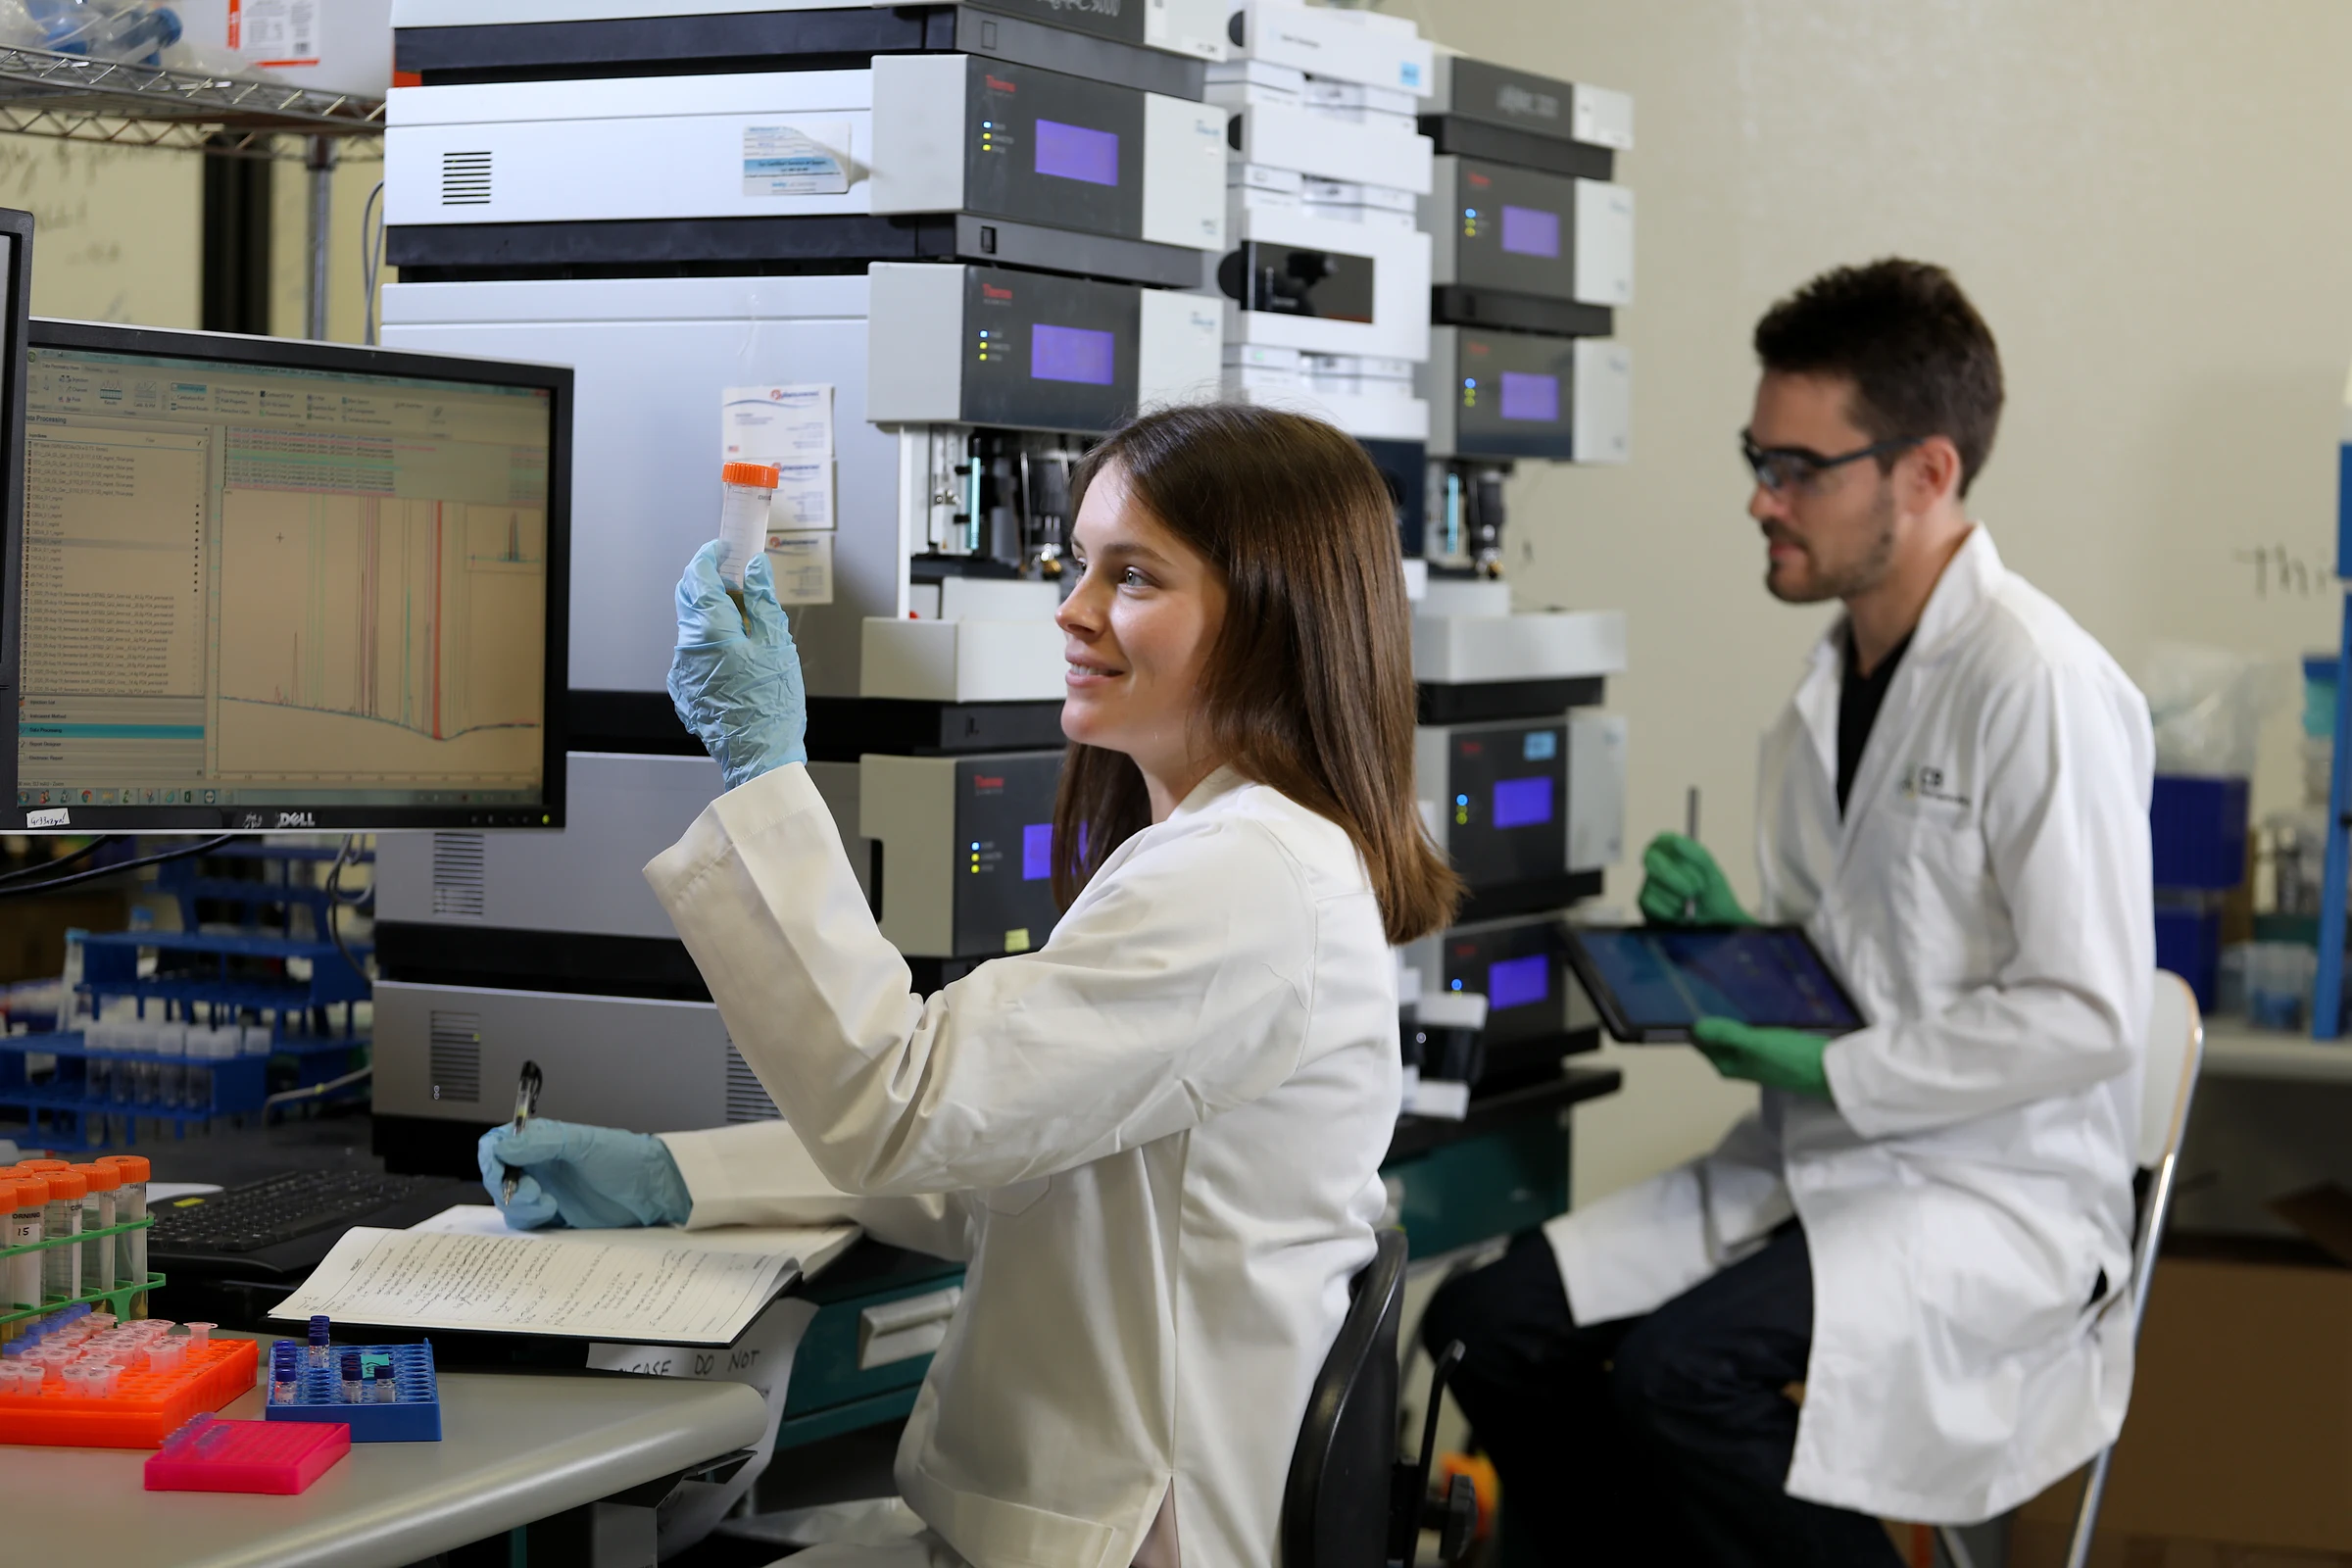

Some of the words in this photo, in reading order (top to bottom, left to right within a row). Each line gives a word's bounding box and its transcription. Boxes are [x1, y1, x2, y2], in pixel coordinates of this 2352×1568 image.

[280, 810, 315, 826] DELL
[12, 1211, 41, 1220] ORNING
[18, 1227, 30, 1236] 15
[693, 1353, 715, 1376] DO
[727, 1348, 761, 1373] NOT
